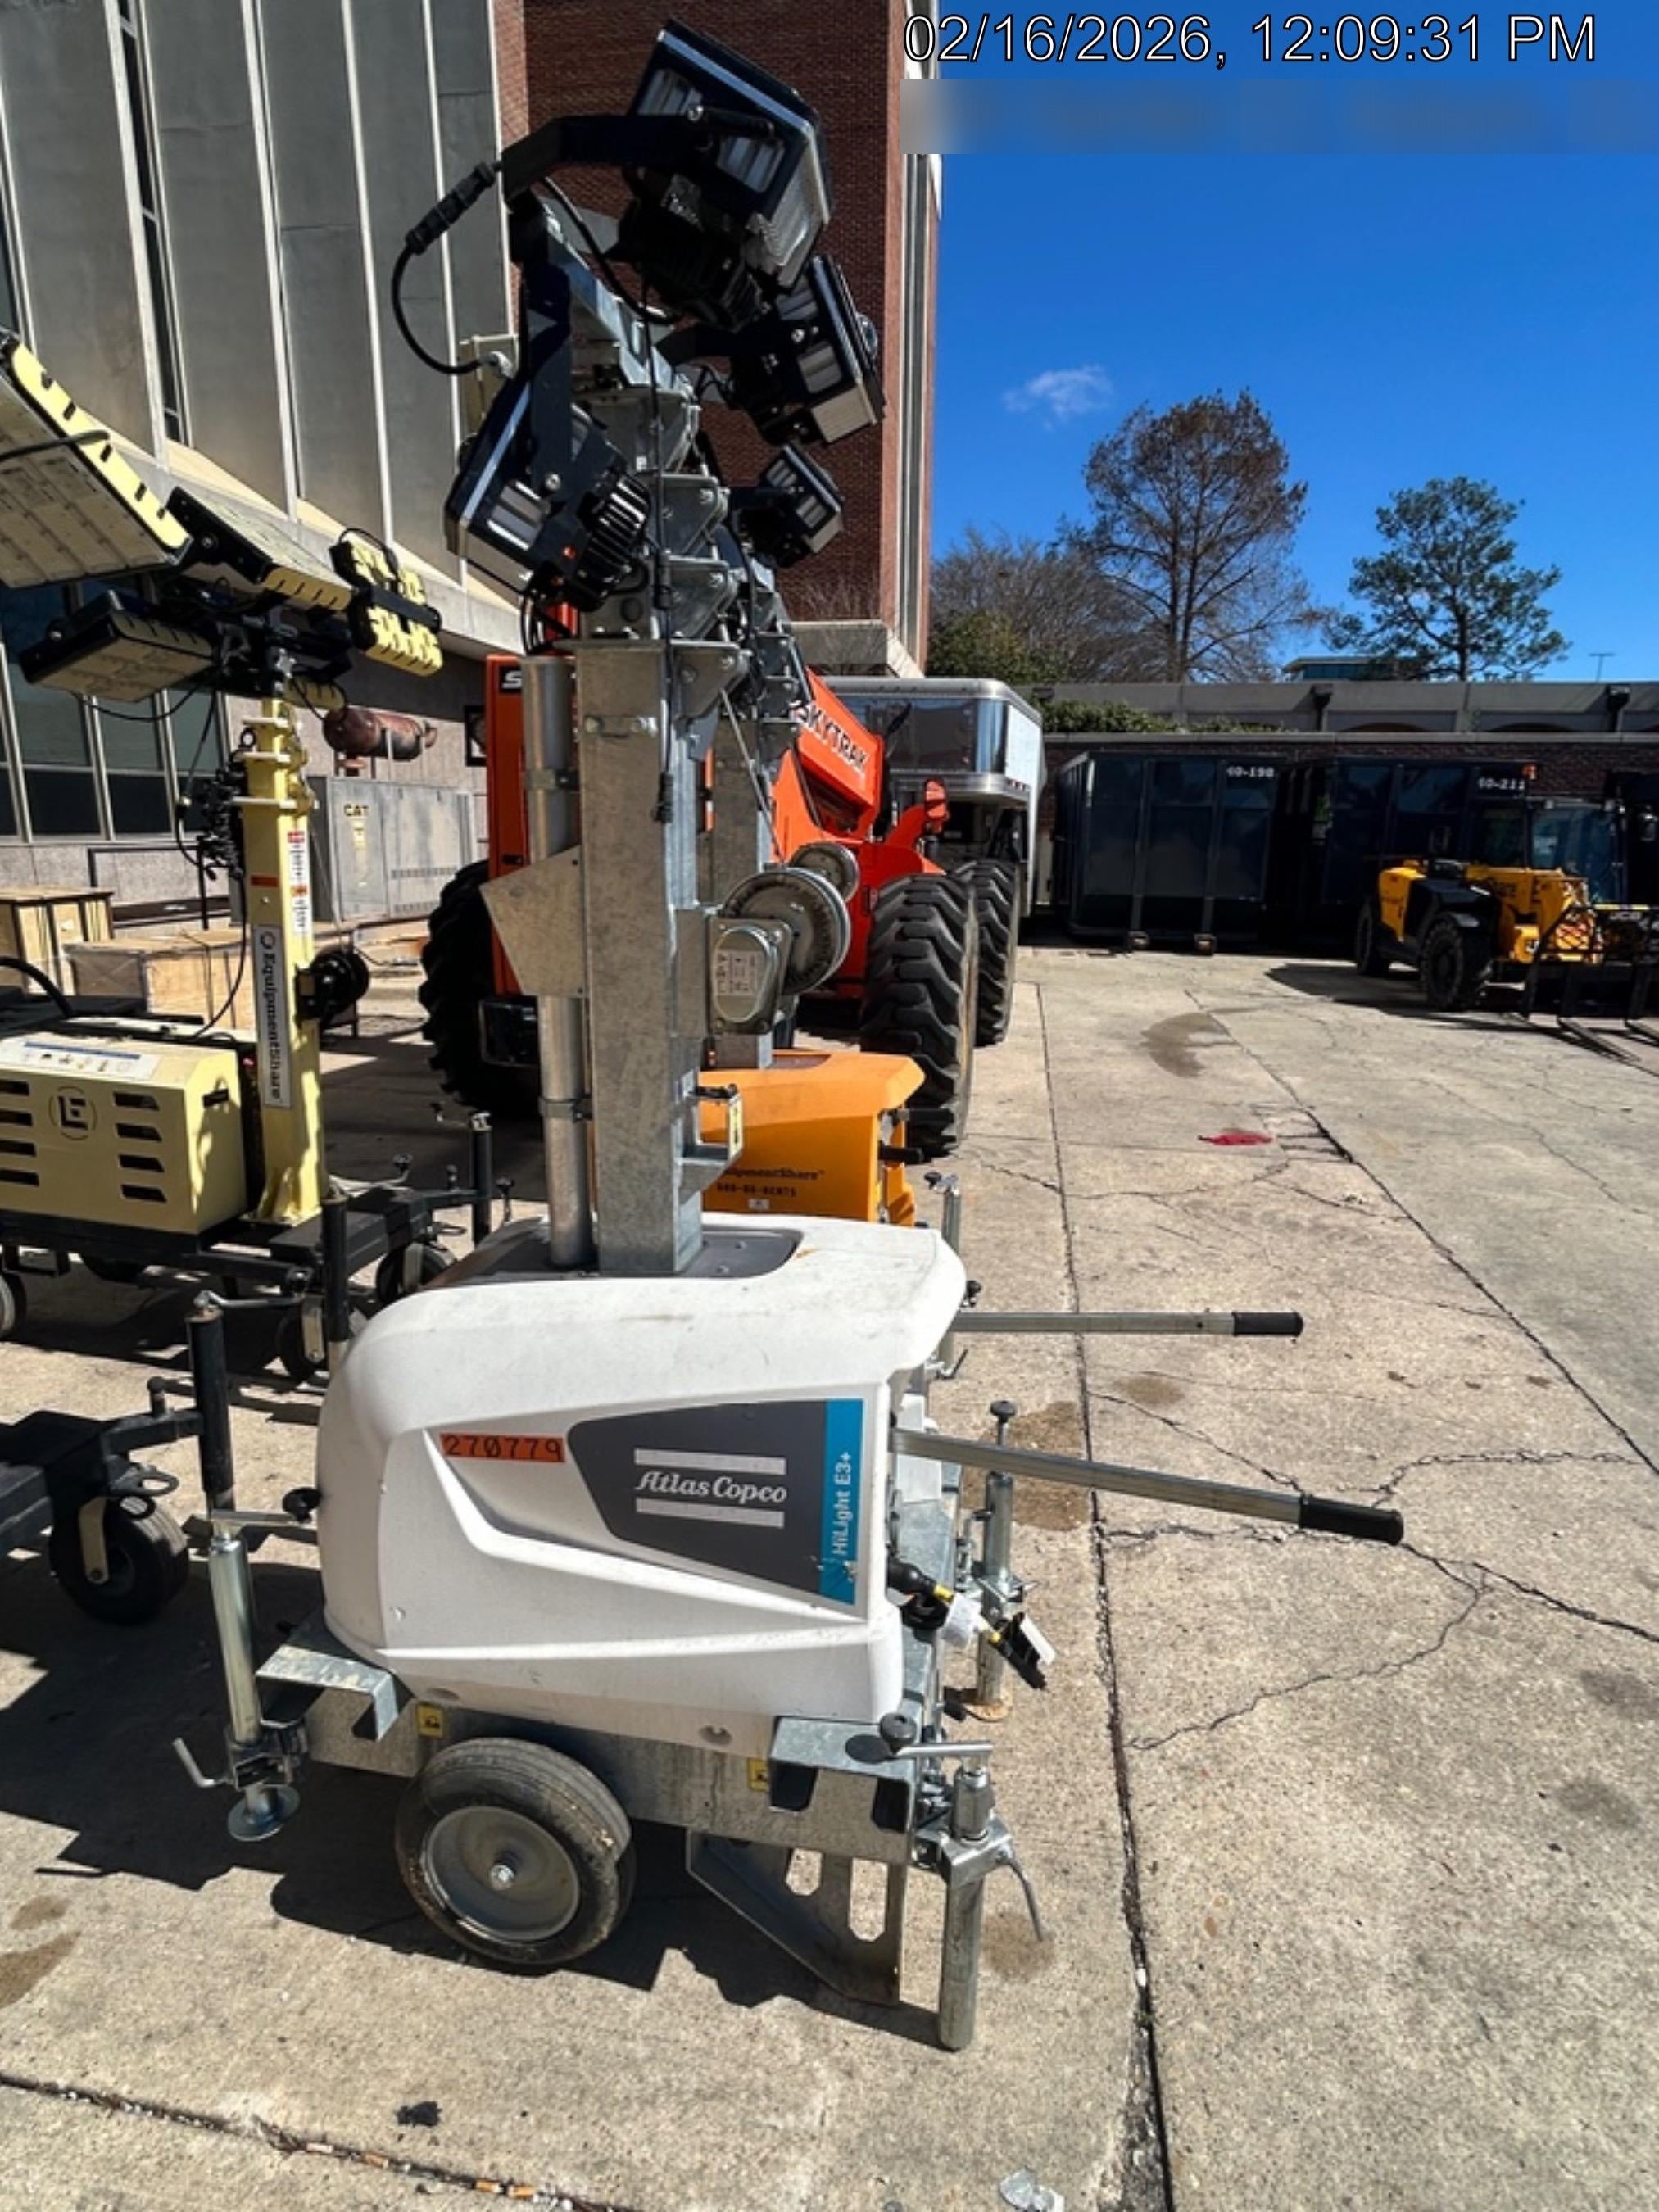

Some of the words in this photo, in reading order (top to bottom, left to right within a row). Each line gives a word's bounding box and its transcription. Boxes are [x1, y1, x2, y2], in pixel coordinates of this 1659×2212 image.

[344, 804, 369, 817] CAT
[262, 953, 281, 1099] EquipmentShare
[443, 1435, 561, 1462] 270779
[834, 1451, 851, 1484] E3+
[634, 1471, 709, 1496] Atlas
[712, 1476, 787, 1504] Copco
[832, 1491, 854, 1555] HiLight
